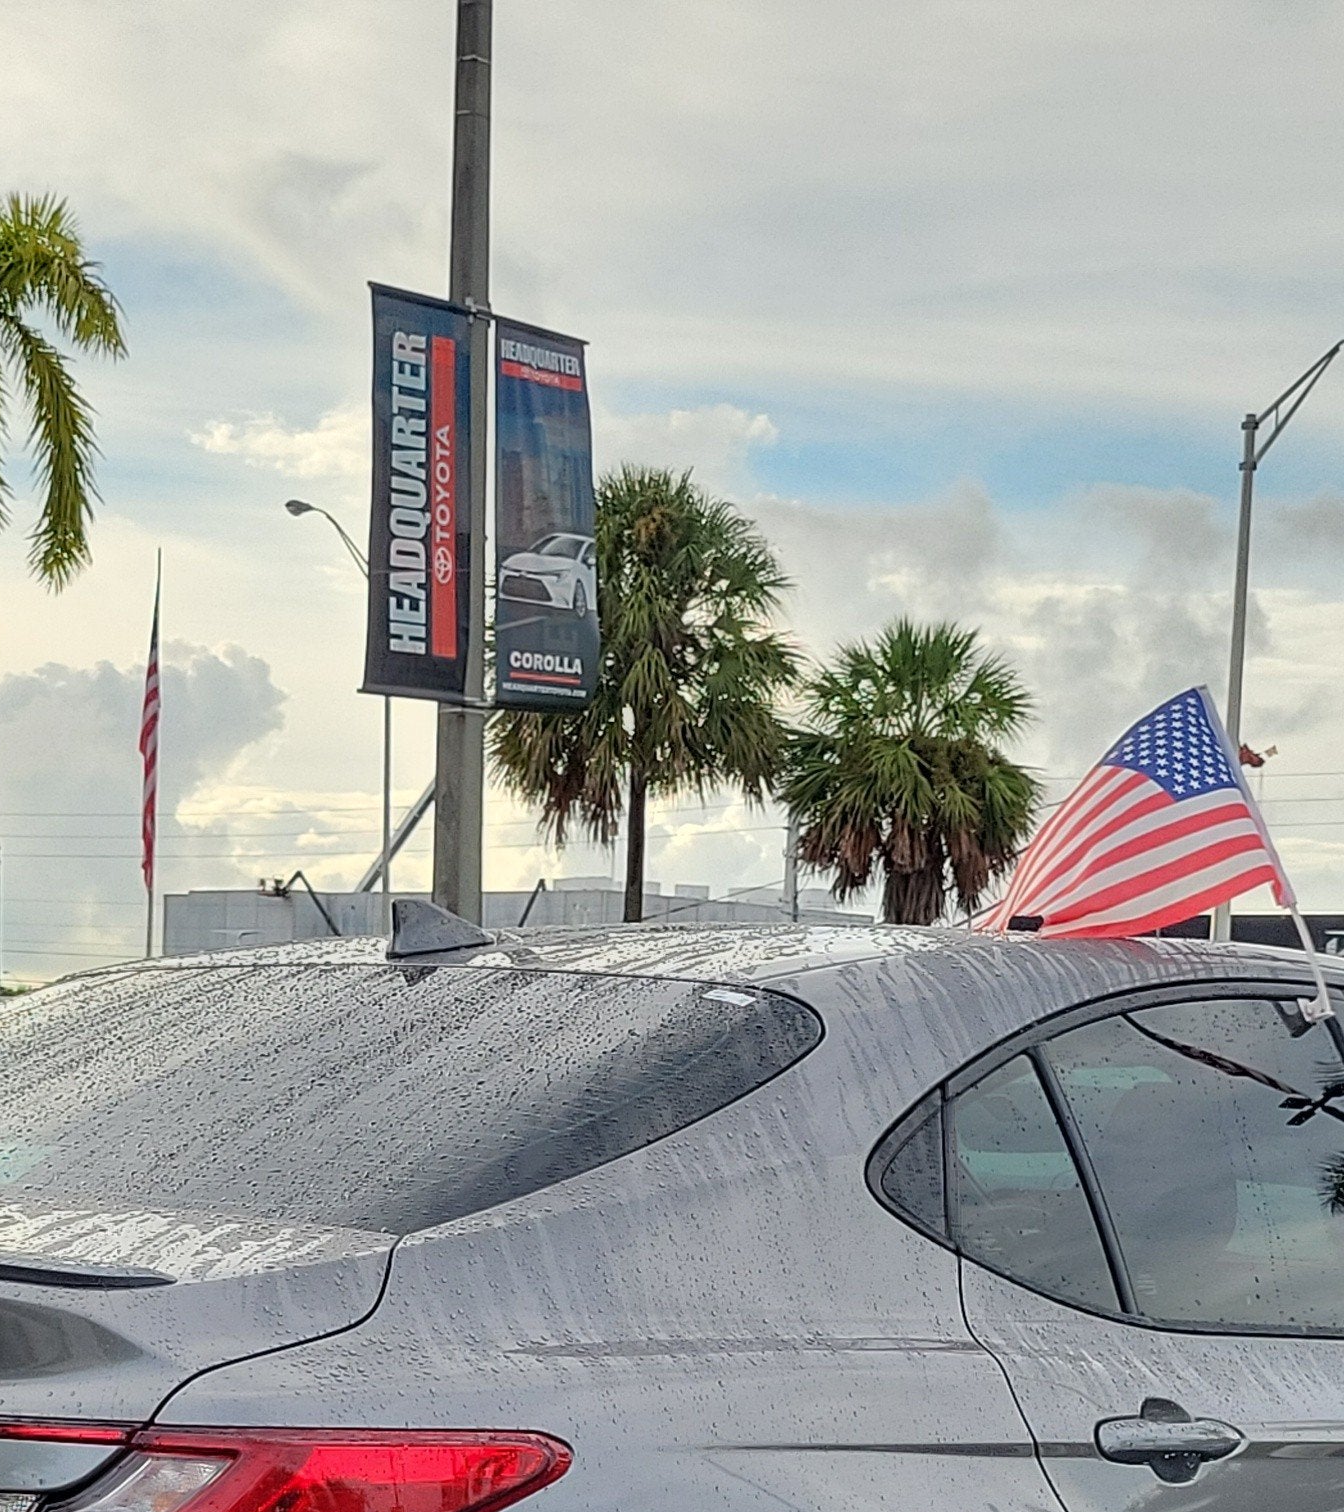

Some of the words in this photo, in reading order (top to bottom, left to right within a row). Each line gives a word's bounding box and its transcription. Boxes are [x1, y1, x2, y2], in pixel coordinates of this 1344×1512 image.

[501, 338, 581, 377] HEADQUARTER
[389, 331, 431, 655] HEADQUARTER
[436, 424, 451, 544] TOYOTA
[510, 651, 583, 675] COROLLA
